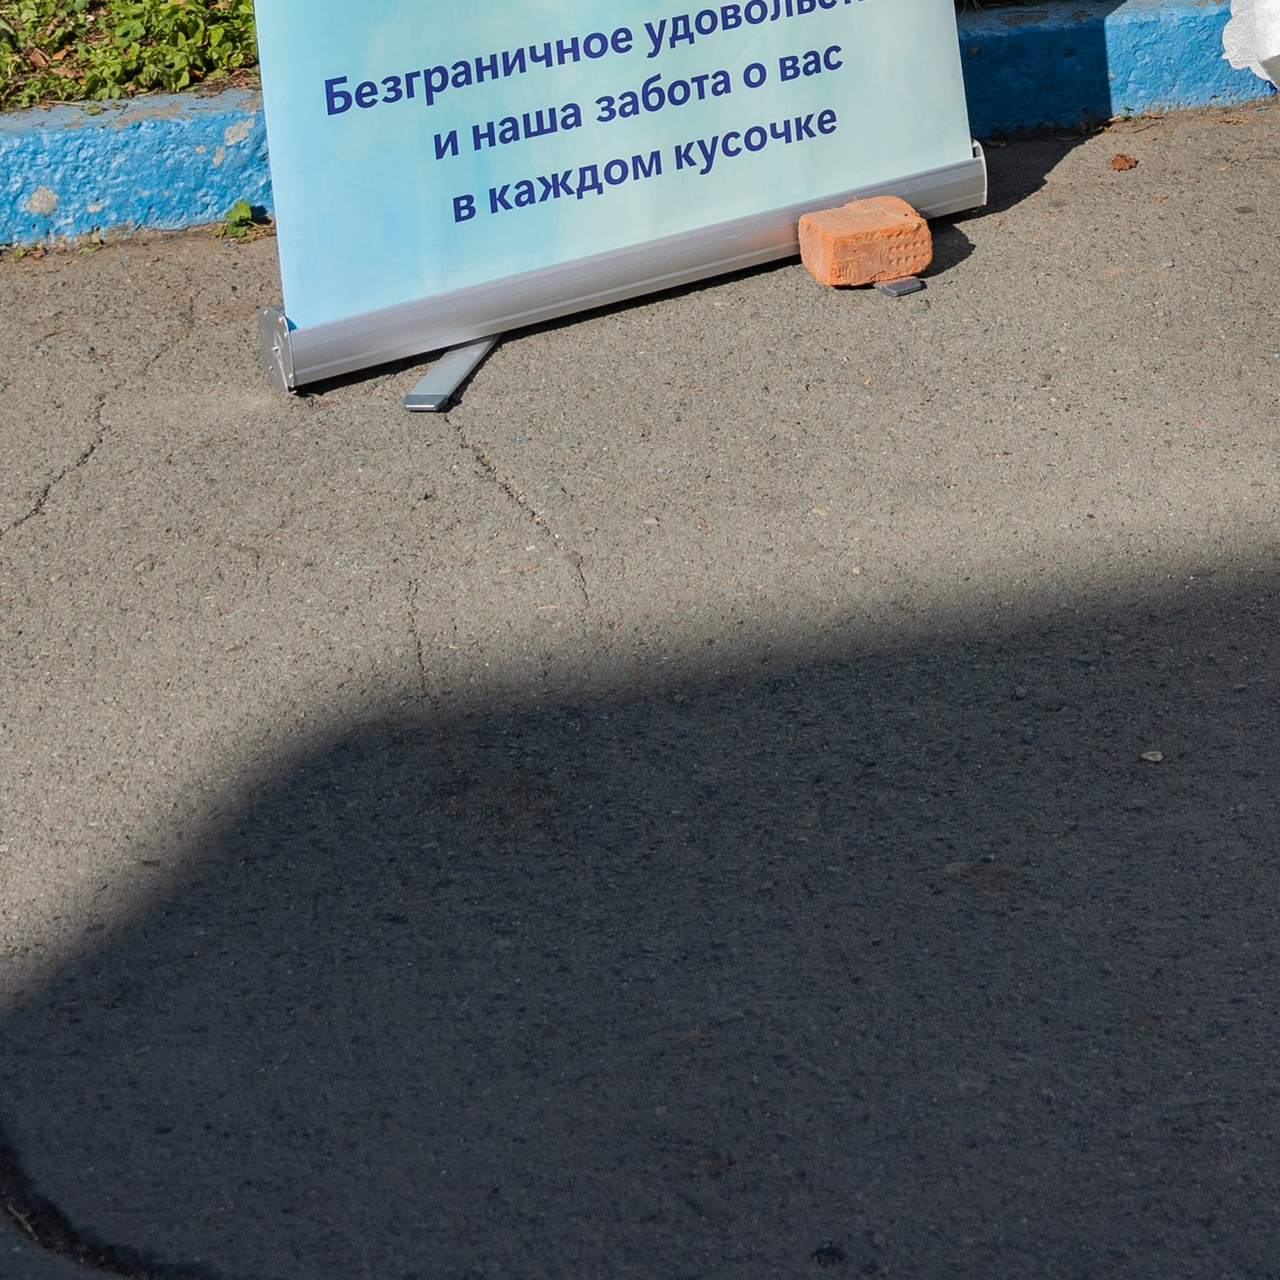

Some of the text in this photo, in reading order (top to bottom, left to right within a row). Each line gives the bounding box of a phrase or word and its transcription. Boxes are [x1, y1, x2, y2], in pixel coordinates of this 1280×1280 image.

[325, 28, 632, 116] Безграничное
[434, 46, 843, 160] и наша забота о вас
[453, 109, 836, 223] в каждом кусочке
